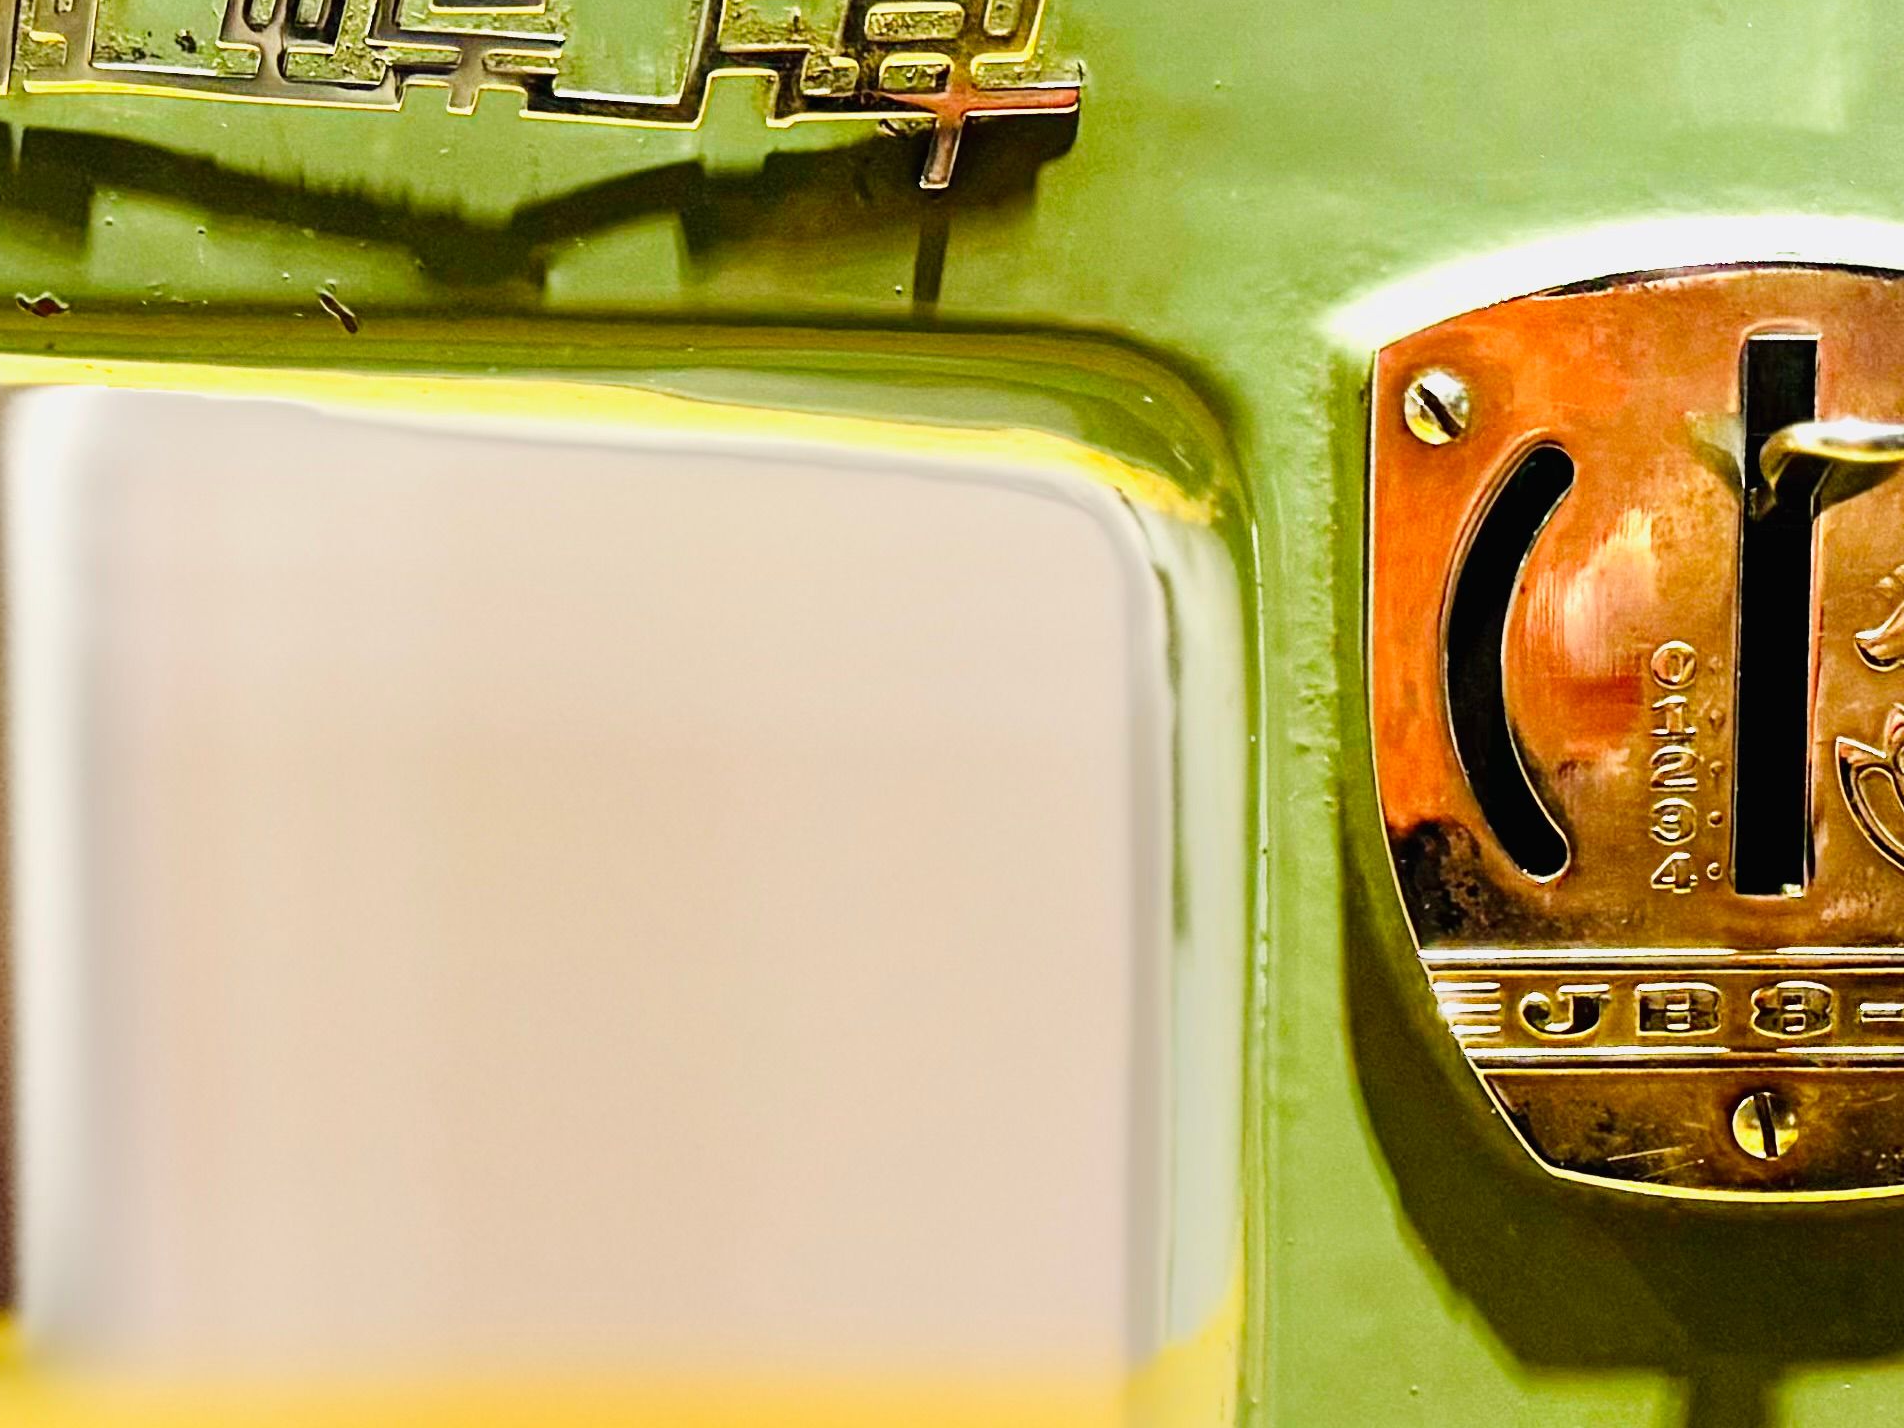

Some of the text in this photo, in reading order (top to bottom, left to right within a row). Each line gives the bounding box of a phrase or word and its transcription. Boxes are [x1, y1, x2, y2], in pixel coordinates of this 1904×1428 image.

[1650, 639, 1697, 690] 0
[1650, 694, 1697, 738] 1
[1649, 744, 1699, 793] 2
[1649, 796, 1697, 847] 3
[1650, 850, 1699, 895] 4
